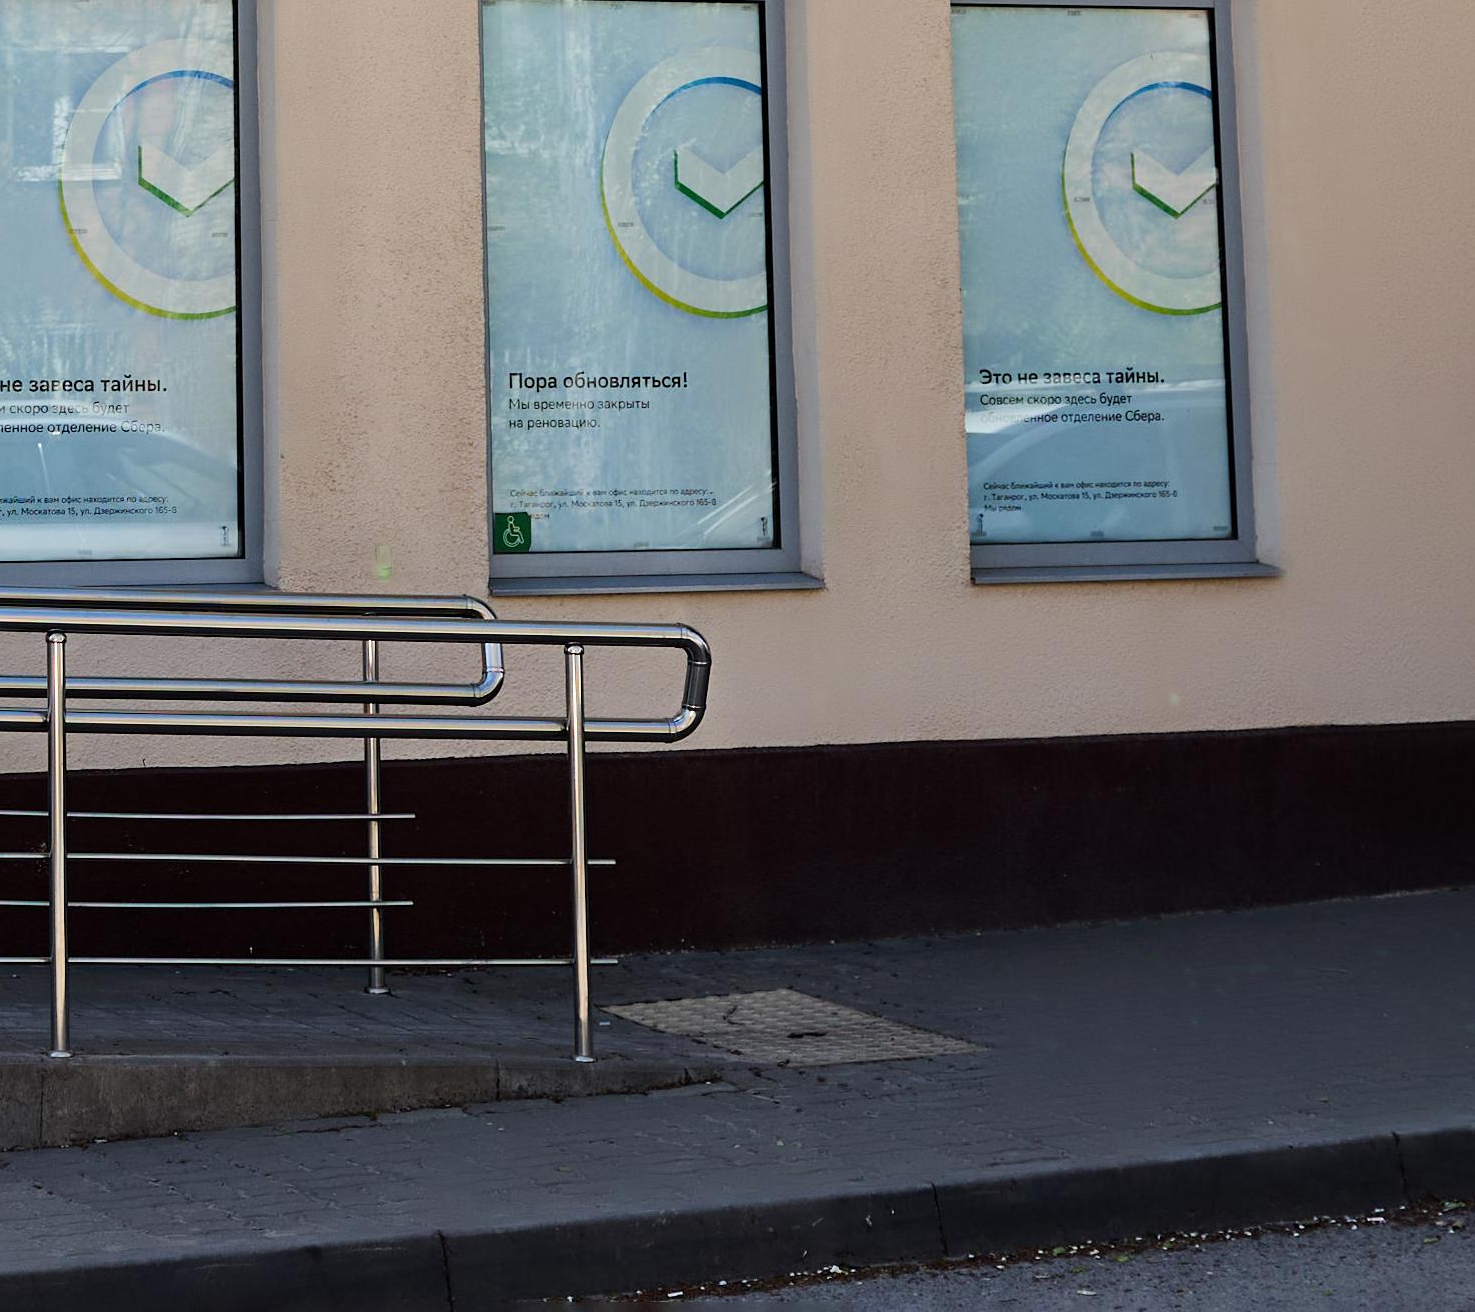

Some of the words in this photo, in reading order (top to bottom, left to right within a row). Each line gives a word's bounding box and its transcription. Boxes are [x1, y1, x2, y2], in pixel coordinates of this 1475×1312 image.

[509, 373, 557, 392] Пора
[564, 372, 688, 388] обновляться!
[979, 369, 1012, 384] Это
[1018, 372, 1038, 384] не
[1043, 372, 1100, 384] завеса
[1106, 367, 1165, 383] тайны.
[0, 380, 22, 392] не
[29, 379, 94, 392] завеса
[101, 375, 167, 392] тайны.
[509, 399, 529, 409] Мы
[534, 400, 594, 412] временно
[598, 399, 649, 411] закрыты
[980, 395, 1024, 405] Совсем
[1027, 395, 1061, 407] скоро
[1065, 395, 1096, 405] здесь
[1100, 393, 1132, 406] будет
[10, 404, 48, 416] скоро
[53, 404, 89, 415] здесь
[93, 401, 129, 416] будет
[1062, 413, 1122, 423] отделение
[1125, 410, 1164, 423] Сбера.
[48, 423, 117, 435] отделение
[121, 420, 165, 435] Сбера.
[509, 420, 523, 428] на
[528, 419, 600, 429] реновацию.
[94, 507, 153, 515] Дзержинского
